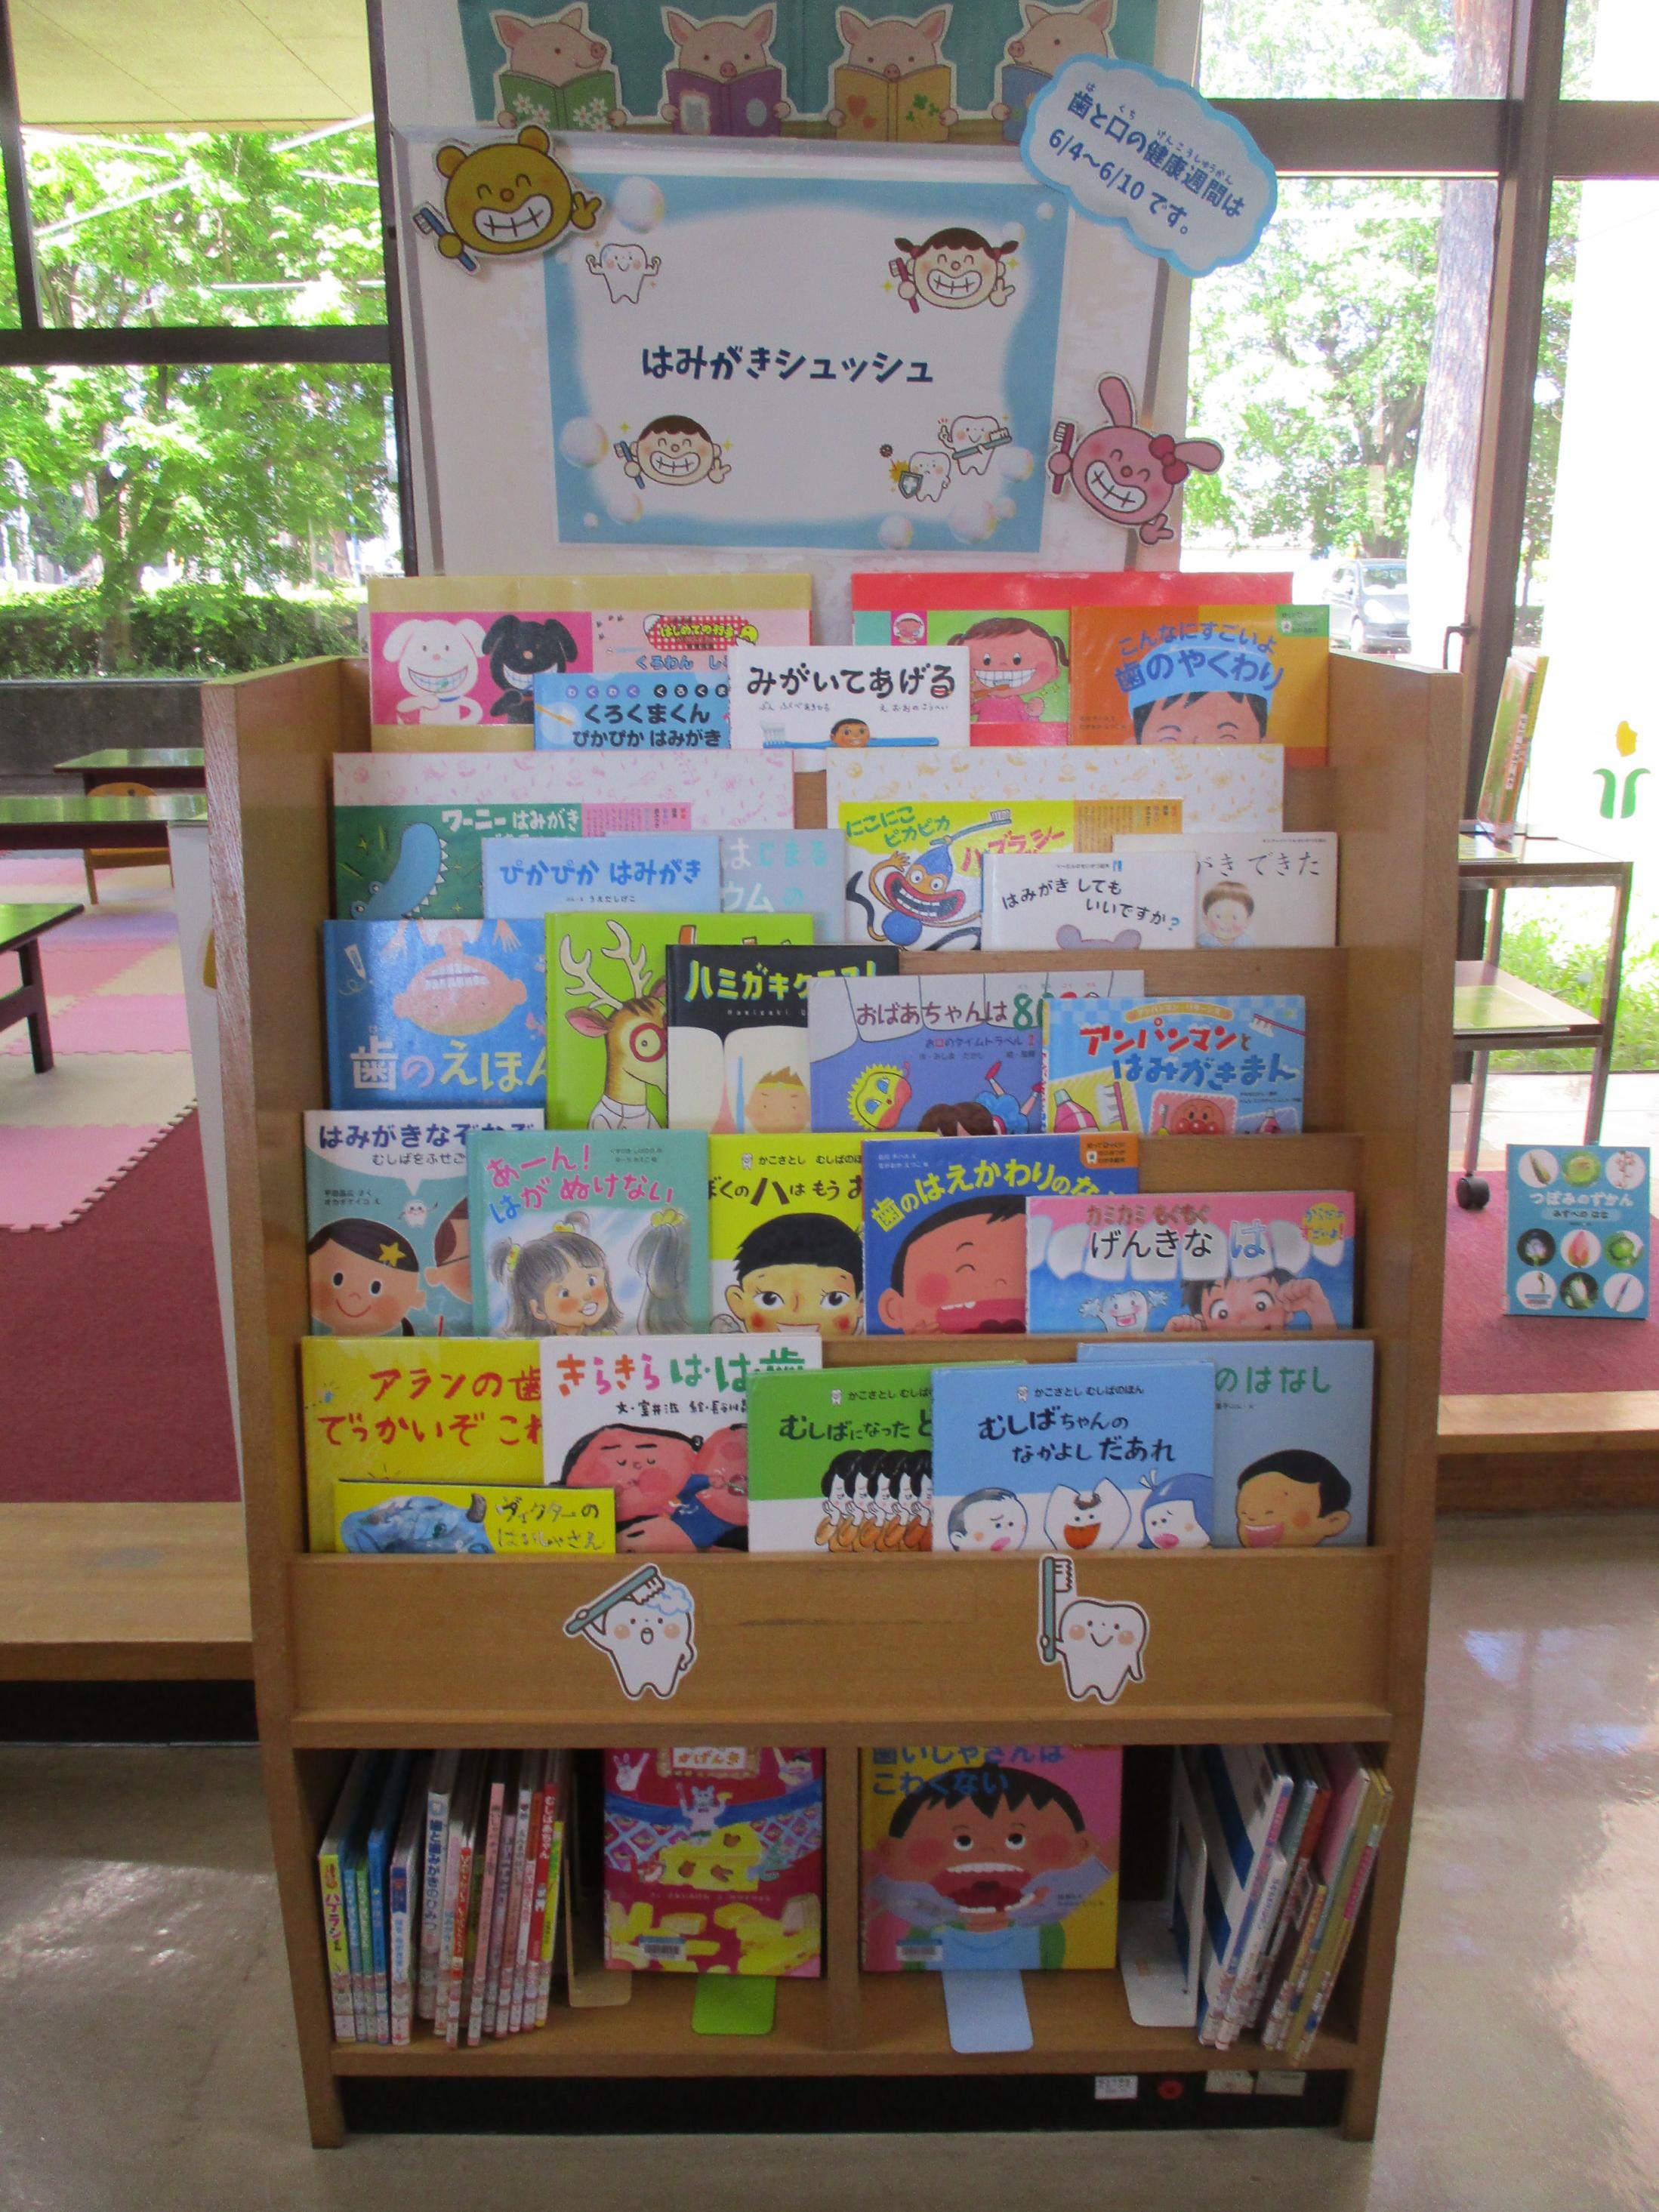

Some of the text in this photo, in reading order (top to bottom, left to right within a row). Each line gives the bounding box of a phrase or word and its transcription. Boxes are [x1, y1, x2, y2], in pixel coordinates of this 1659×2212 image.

[1067, 90, 1245, 217] 歯と口の健康週間は
[643, 345, 933, 384] はみがきシュッシュ
[1119, 621, 1278, 656] こんなにすごいよ
[635, 655, 693, 670] くろわん
[1115, 649, 1285, 693] 歯のやくわり
[748, 662, 956, 698] みがいてあげる
[584, 703, 711, 724] くろくまくん
[572, 729, 722, 747] ぴかぴか はみがき
[512, 808, 580, 831] はみがき
[846, 806, 915, 837] にこにこ
[884, 815, 950, 848] ピカピカ
[500, 859, 702, 886] ぴかぴか はみがき
[1247, 851, 1321, 876] できた
[1002, 878, 1123, 910] はみがき しても
[1112, 1052, 1297, 1091] はみがきまん
[758, 1155, 806, 1166] かこさとし
[560, 1172, 674, 1204] ぬけない
[813, 1179, 840, 1200] もう
[871, 1159, 1115, 1232] 歯のはえかわりのな
[1529, 1191, 1634, 1207] つぼみのずかん
[1086, 1203, 1147, 1226] カミカミ
[1090, 1218, 1266, 1260] げんきな は
[557, 1353, 660, 1397] きらきら
[847, 1388, 933, 1401] かこさとし むしば
[1034, 1385, 1145, 1398] かこさとし むしばのほん
[317, 1413, 486, 1447] でっかいぞ
[779, 1414, 911, 1442] むしばになった
[977, 1405, 1129, 1440] むしばちゃんの
[1011, 1436, 1176, 1464] なかよし だあれ
[873, 1771, 1010, 1796] こわくない
